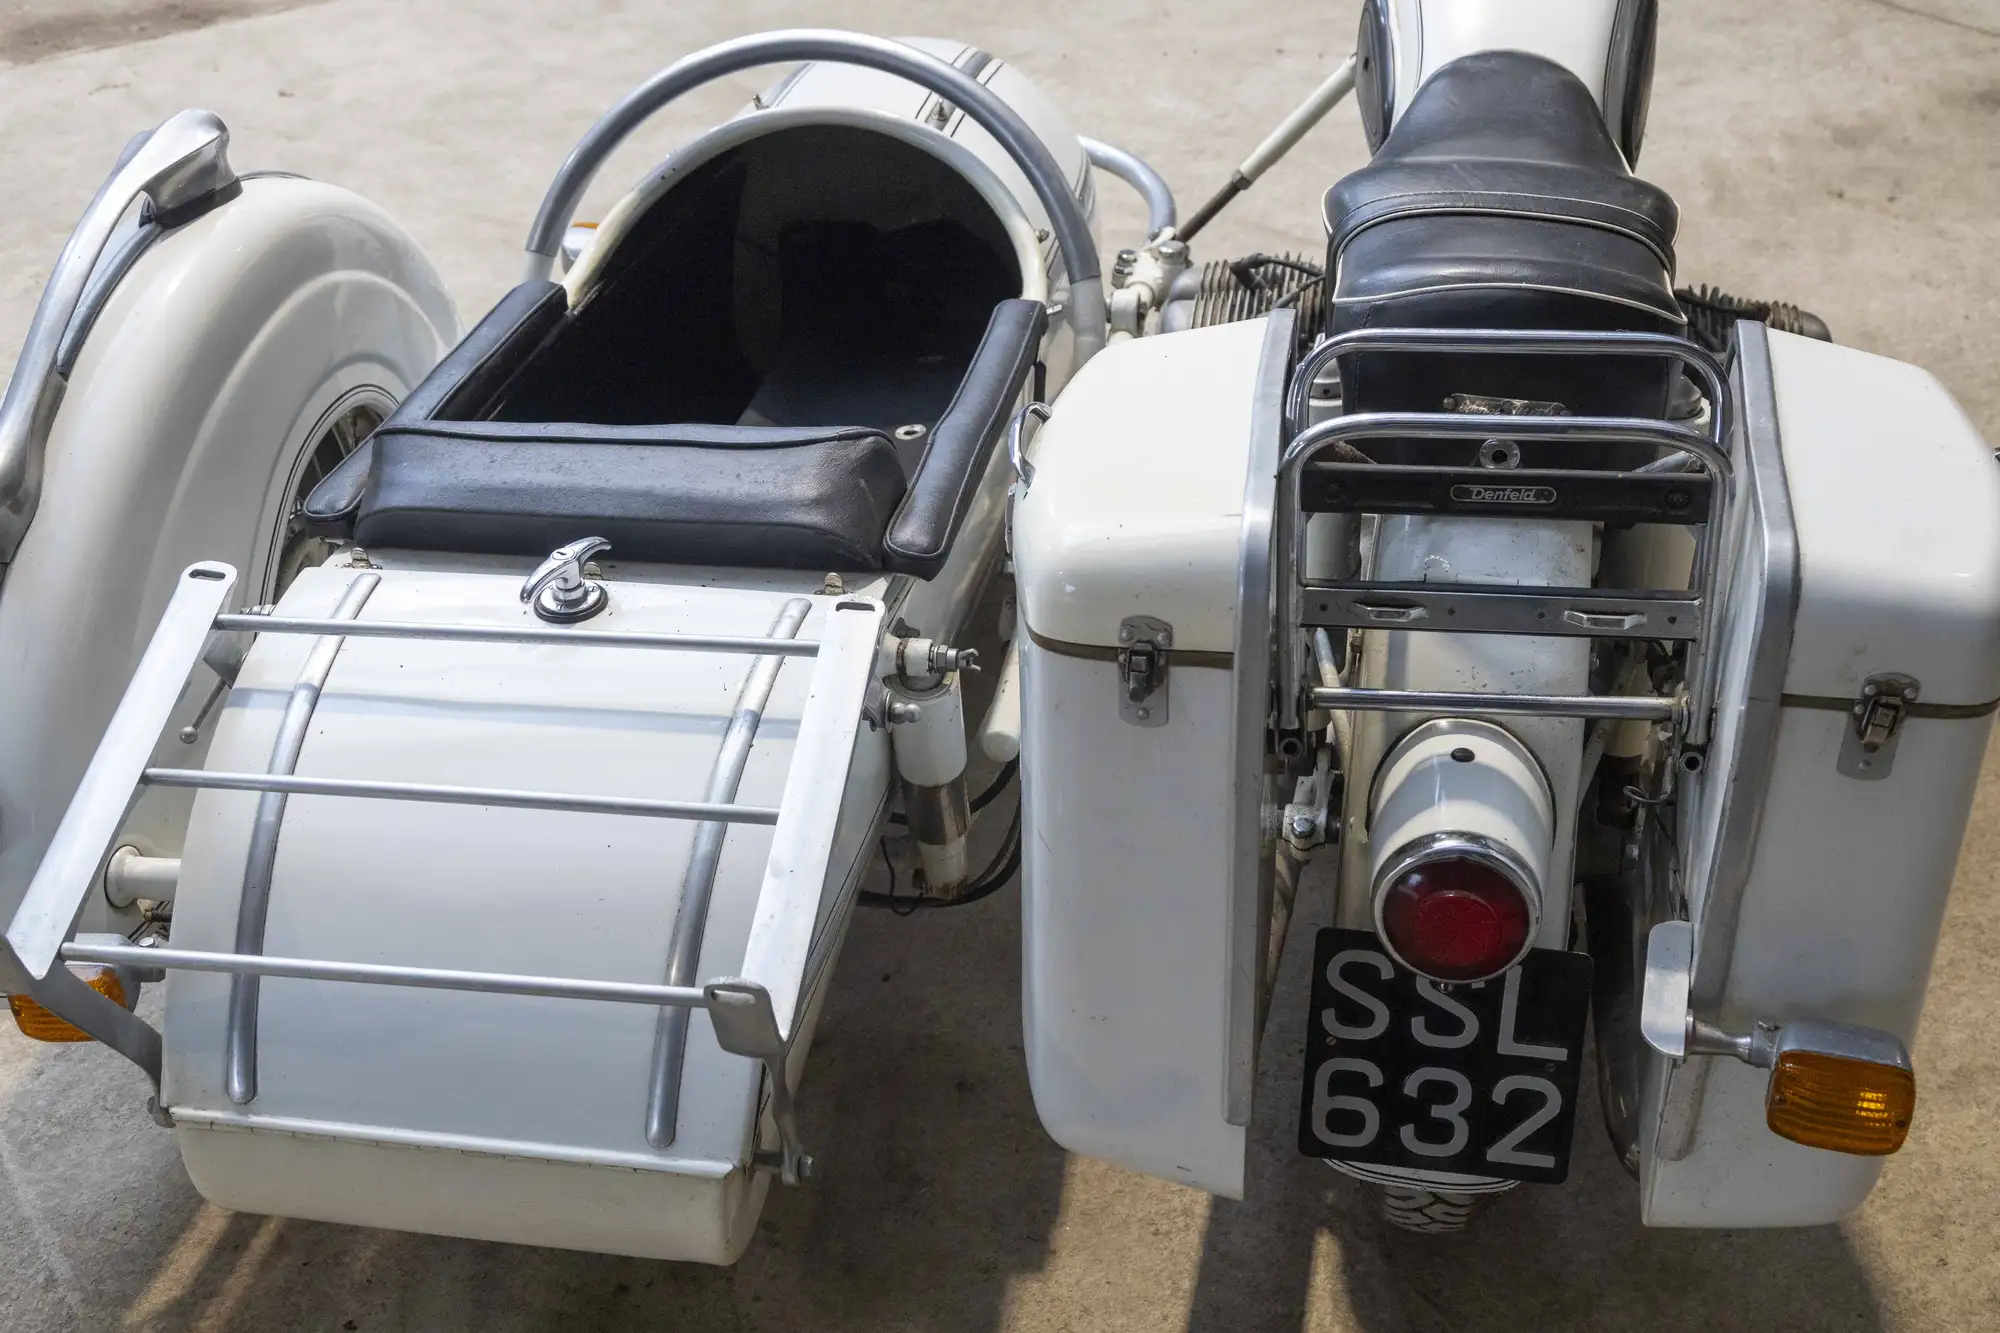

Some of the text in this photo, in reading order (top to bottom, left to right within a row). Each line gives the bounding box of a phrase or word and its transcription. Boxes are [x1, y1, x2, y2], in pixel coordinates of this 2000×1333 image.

[1469, 487, 1537, 501] Denfeld
[1321, 949, 1568, 1061] SSL
[1311, 1056, 1562, 1168] 632
